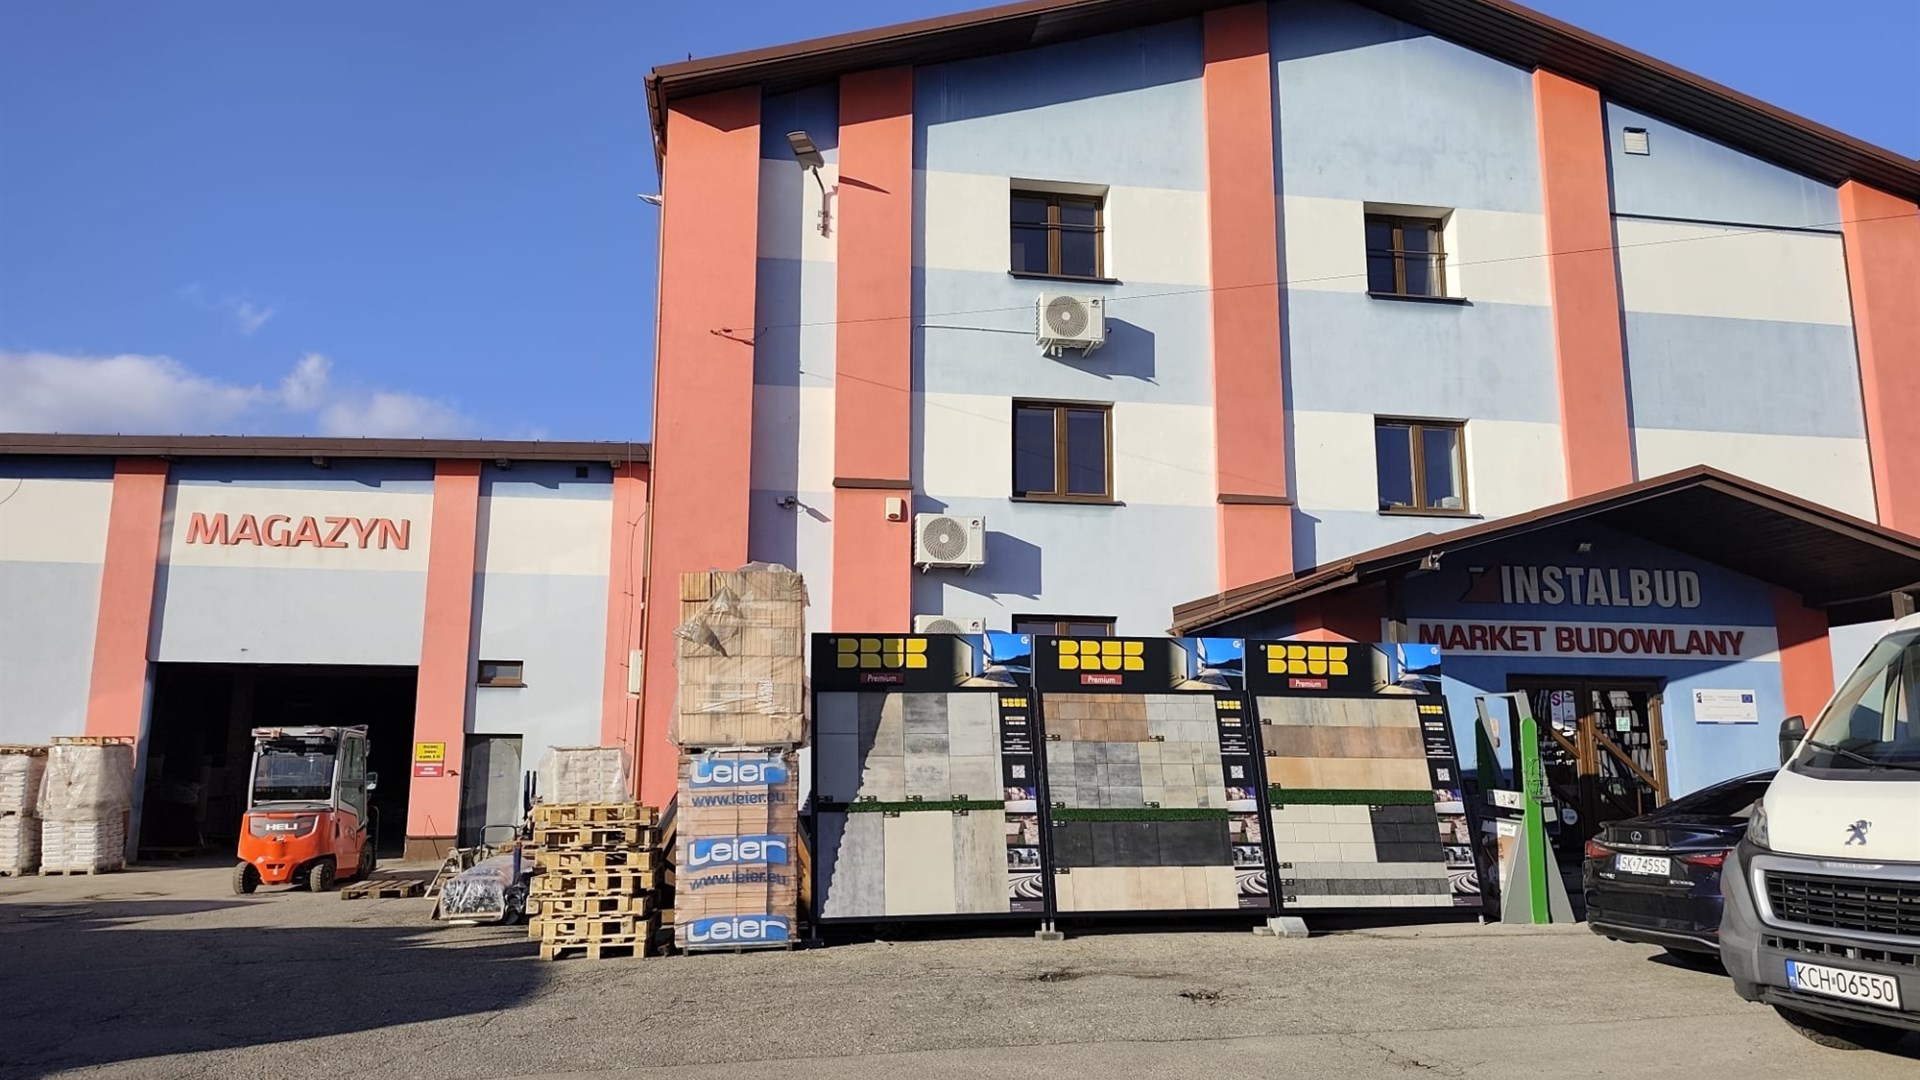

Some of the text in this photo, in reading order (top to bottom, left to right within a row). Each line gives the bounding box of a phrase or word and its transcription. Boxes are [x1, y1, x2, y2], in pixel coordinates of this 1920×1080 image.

[186, 512, 411, 550] MAGAZYN
[1500, 565, 1701, 609] INSTALBUD
[1419, 623, 1745, 656] MARKET BUDOWLANY
[837, 638, 928, 668] BRUK
[1058, 640, 1145, 671] BRUK
[1267, 644, 1349, 676] BRUK
[866, 673, 898, 683] Premium
[1087, 675, 1116, 684] Premium
[1294, 679, 1323, 688] Premium
[690, 760, 787, 784] Leier
[691, 791, 785, 808] www.leier.eu
[265, 822, 298, 831] HELI
[688, 838, 787, 866] Leier
[1621, 856, 1633, 870] SK
[690, 868, 788, 891] www.leier.eu
[686, 917, 787, 942] Leier
[1796, 965, 1895, 1002] KCH 06550
